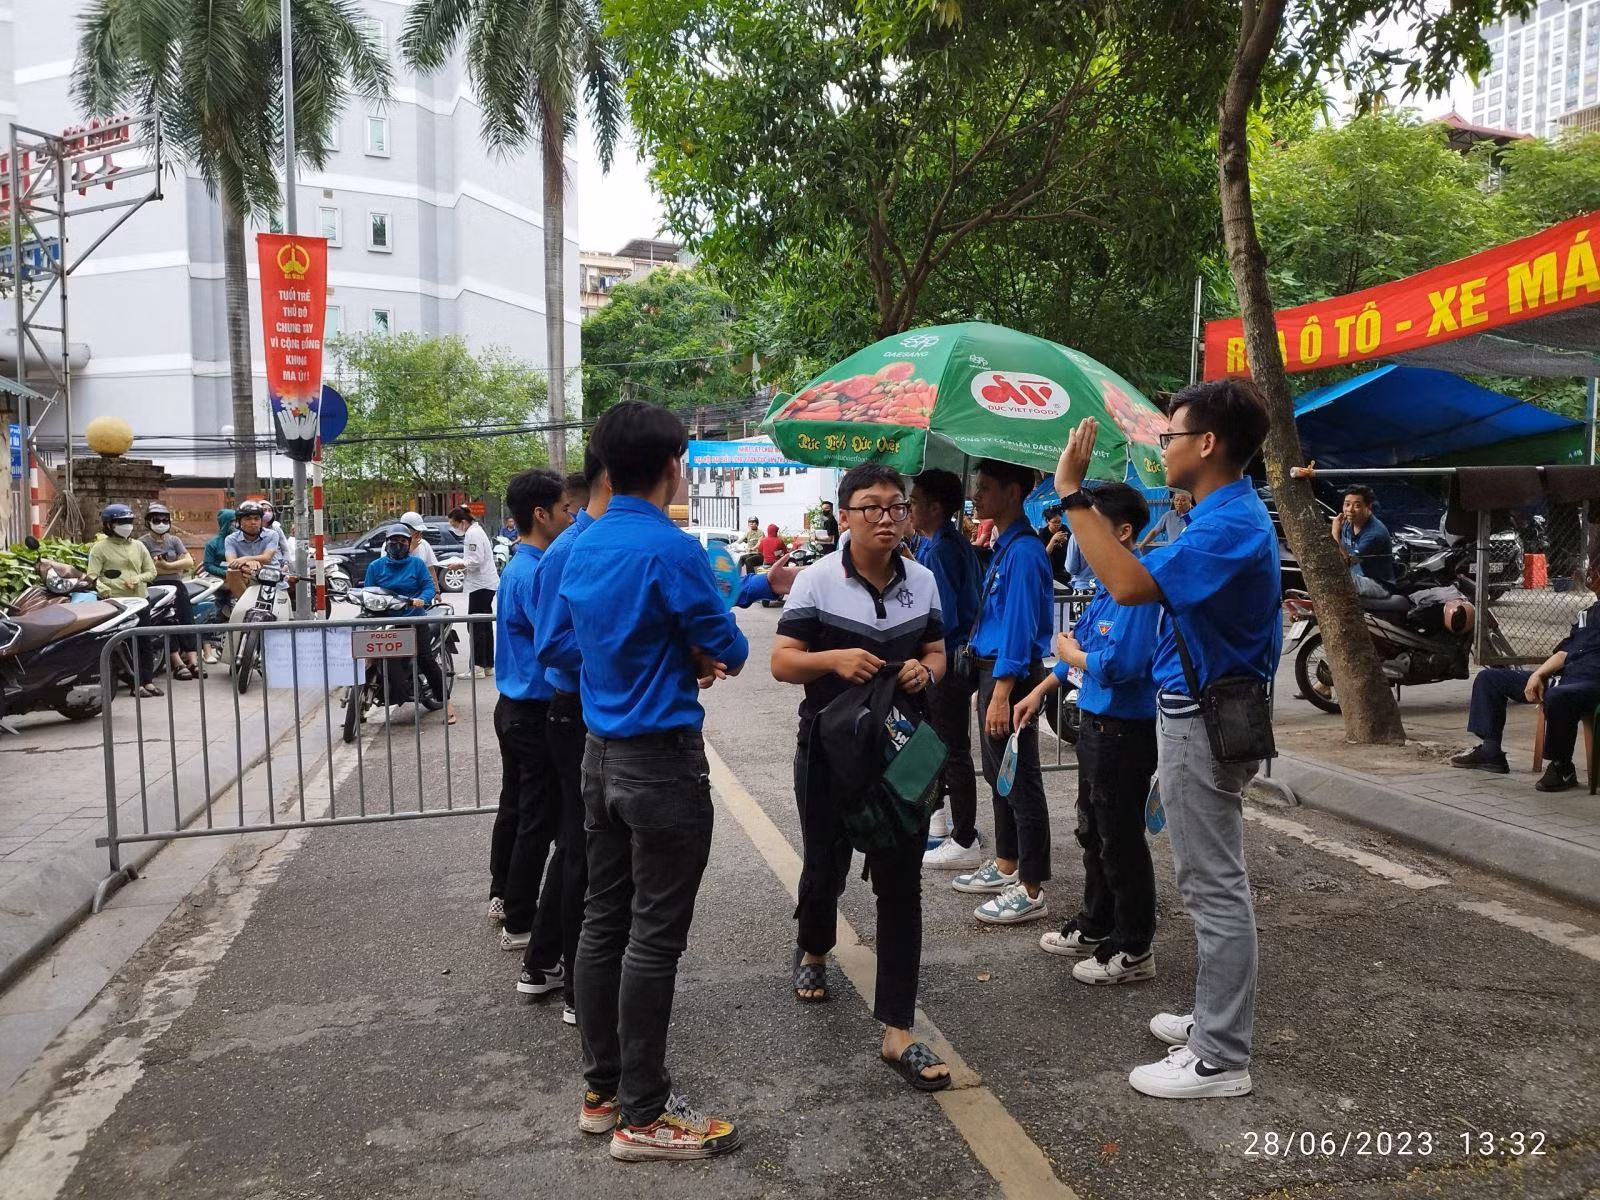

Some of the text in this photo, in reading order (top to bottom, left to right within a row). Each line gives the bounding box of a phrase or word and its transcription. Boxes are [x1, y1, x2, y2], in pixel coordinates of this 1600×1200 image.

[1300, 315, 1323, 365] Ô
[1334, 301, 1382, 358] TÔ
[1426, 276, 1489, 337] XE
[276, 322, 301, 333] CHUNG
[270, 336, 279, 348] VÌ
[282, 370, 297, 381] MA
[1028, 408, 1059, 416] FOODS
[1032, 443, 1065, 454] DAESAN
[366, 642, 403, 653] STOP
